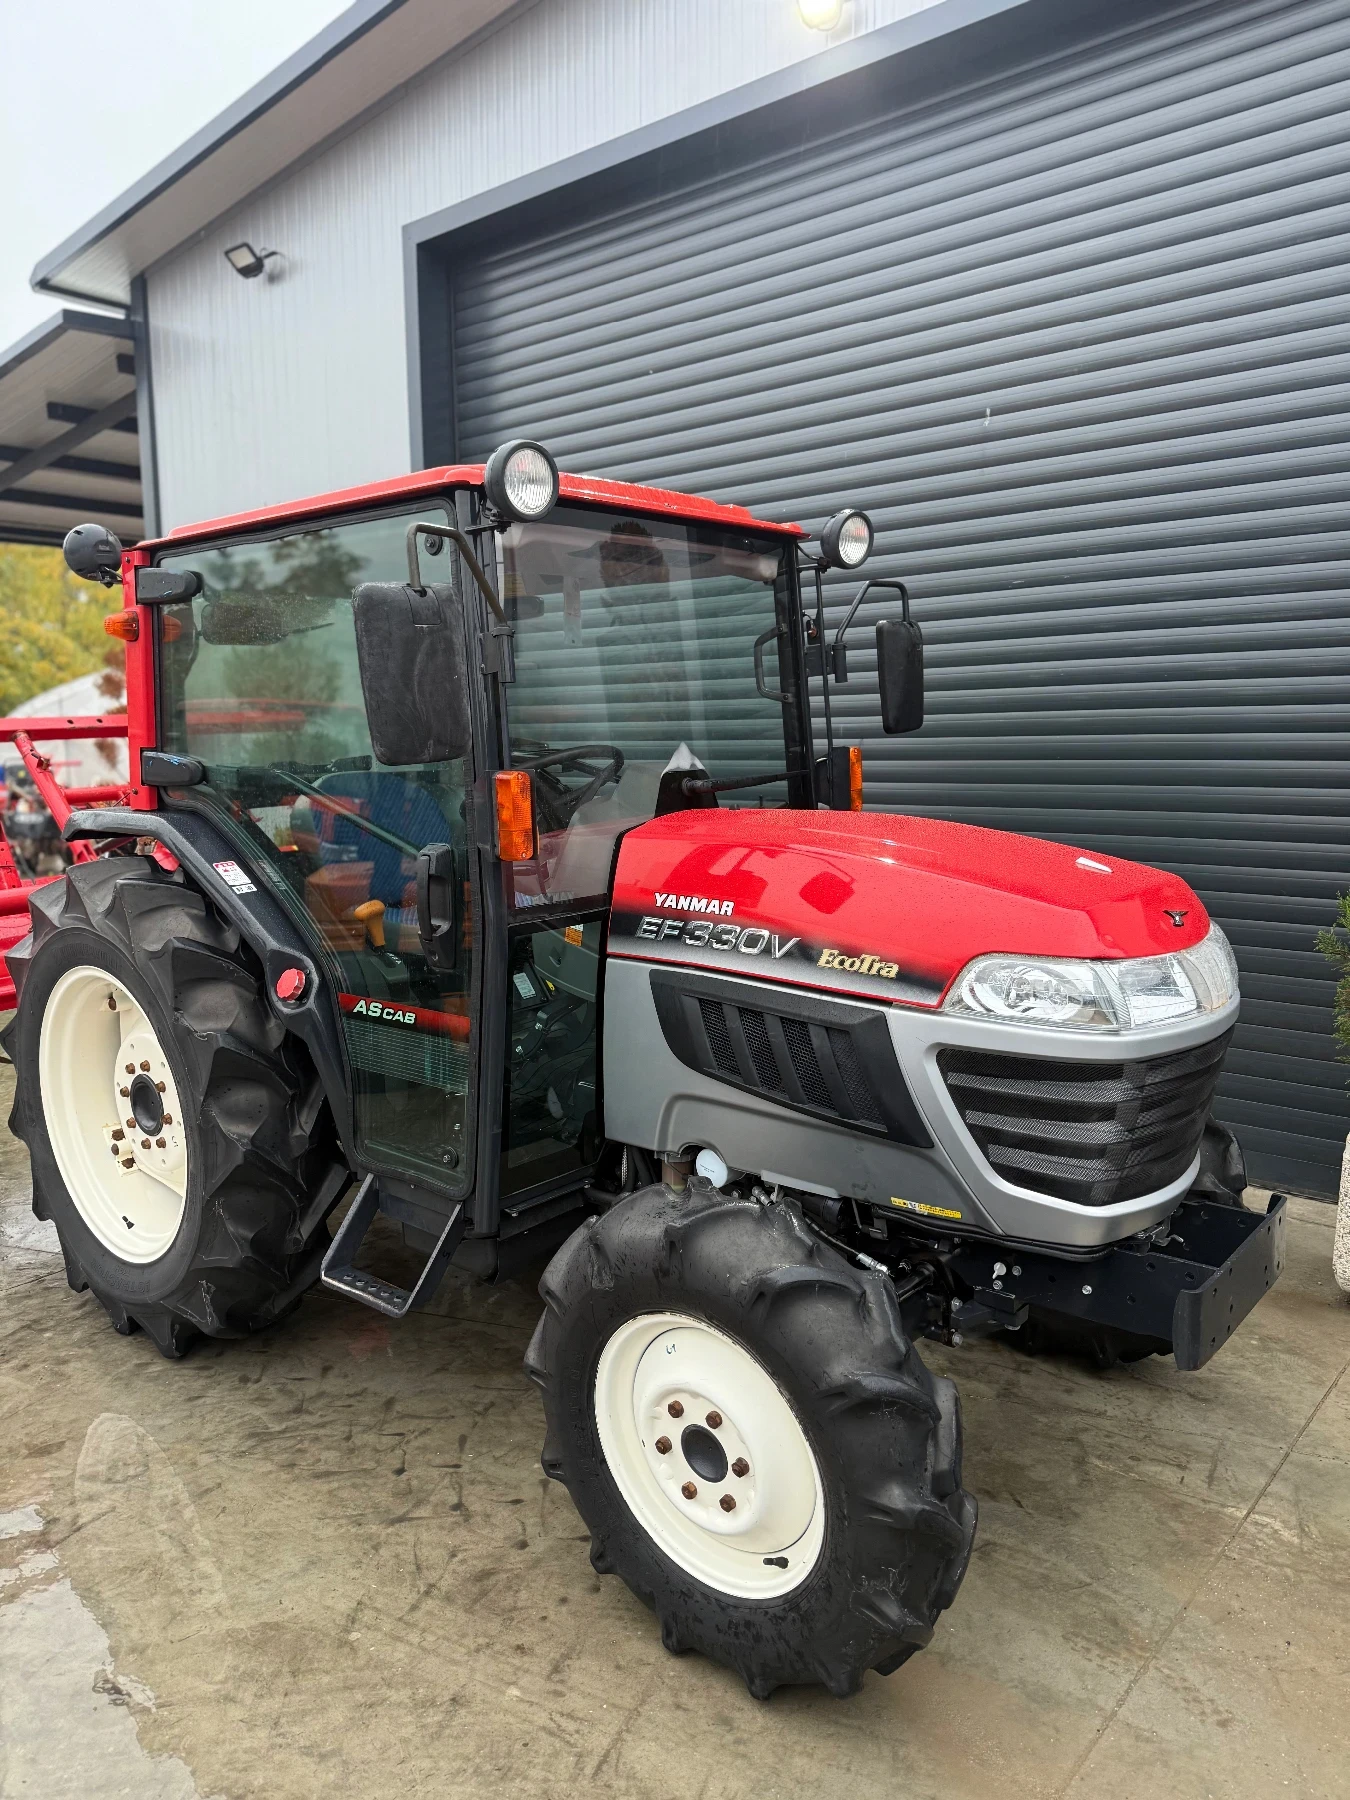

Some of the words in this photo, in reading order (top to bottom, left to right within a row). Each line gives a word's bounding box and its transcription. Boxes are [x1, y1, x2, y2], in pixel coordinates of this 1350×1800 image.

[653, 892, 734, 916] YANMAR
[635, 916, 801, 959] EF330V
[816, 948, 899, 980] EcoTra
[353, 999, 383, 1017] AS
[383, 1008, 416, 1024] CAB
